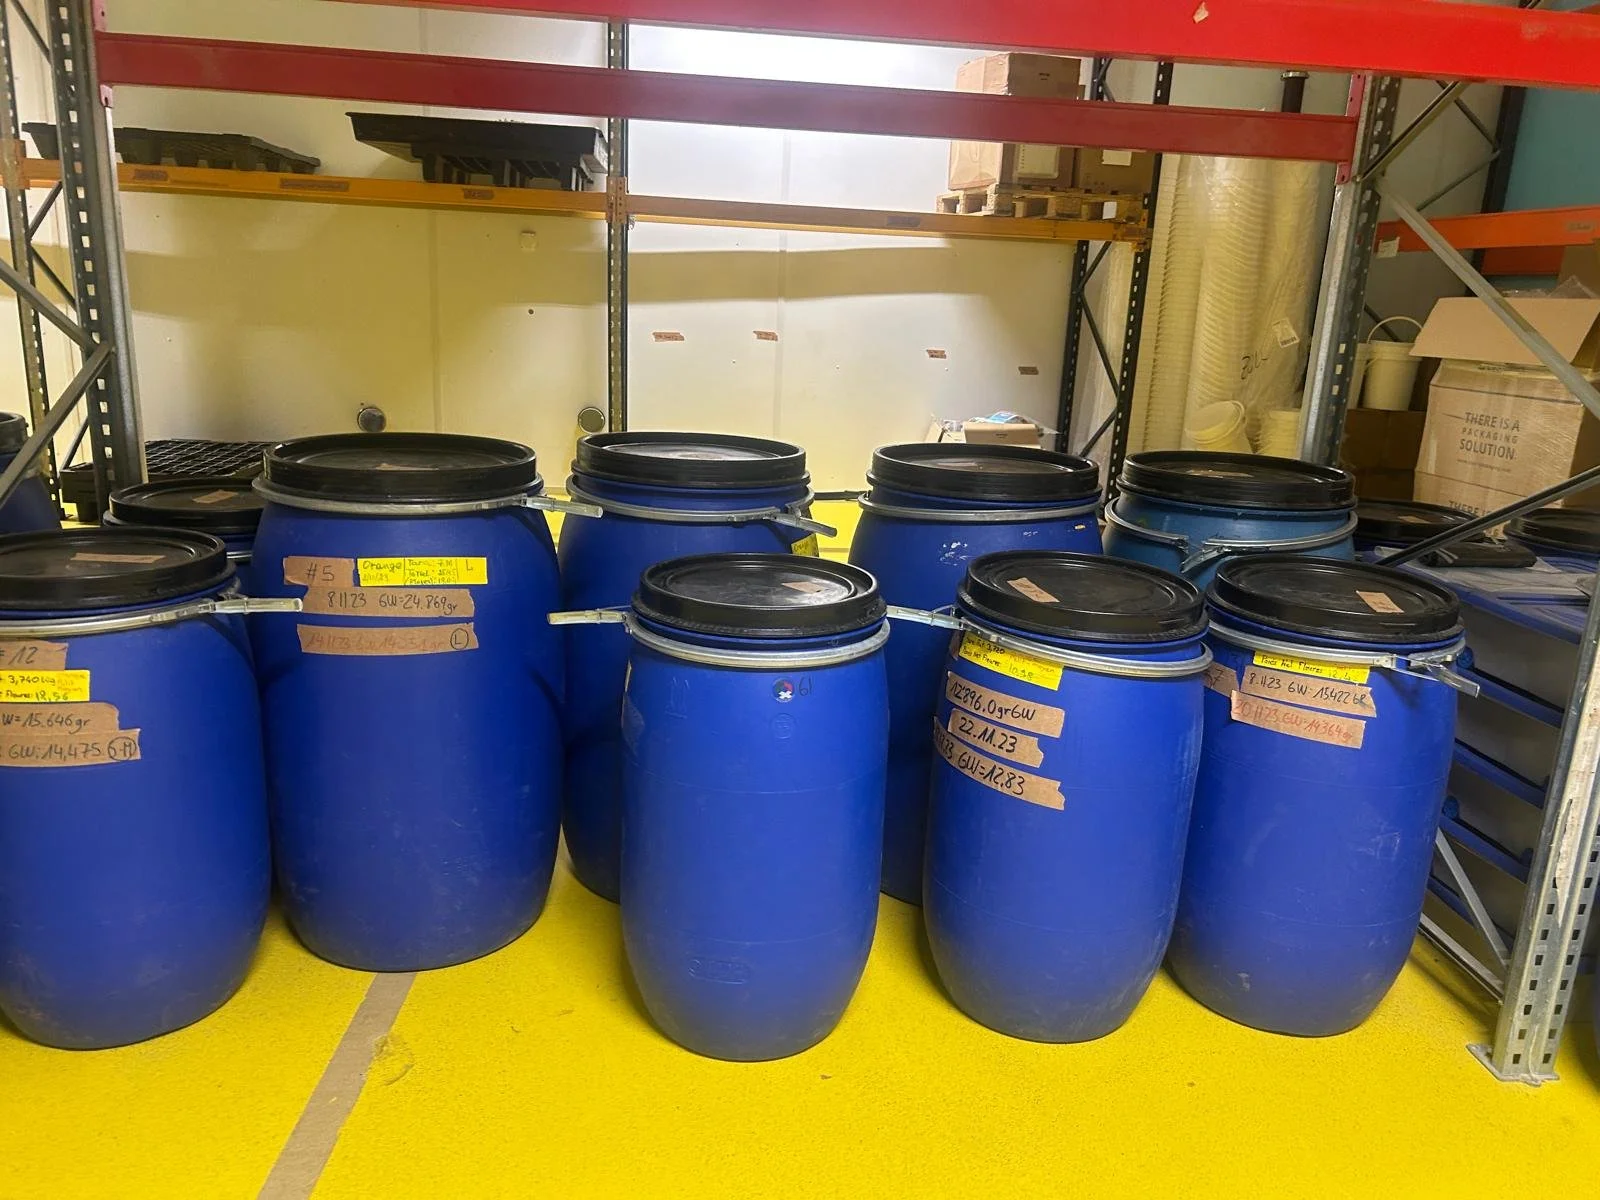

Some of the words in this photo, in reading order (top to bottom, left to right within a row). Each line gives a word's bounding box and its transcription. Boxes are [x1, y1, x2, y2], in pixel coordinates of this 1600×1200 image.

[1465, 412, 1498, 428] THERE
[1500, 417, 1510, 430] IS
[1511, 419, 1520, 432] A
[1462, 427, 1519, 444] PACKAGING
[362, 560, 403, 573] Orange
[465, 560, 475, 572] L
